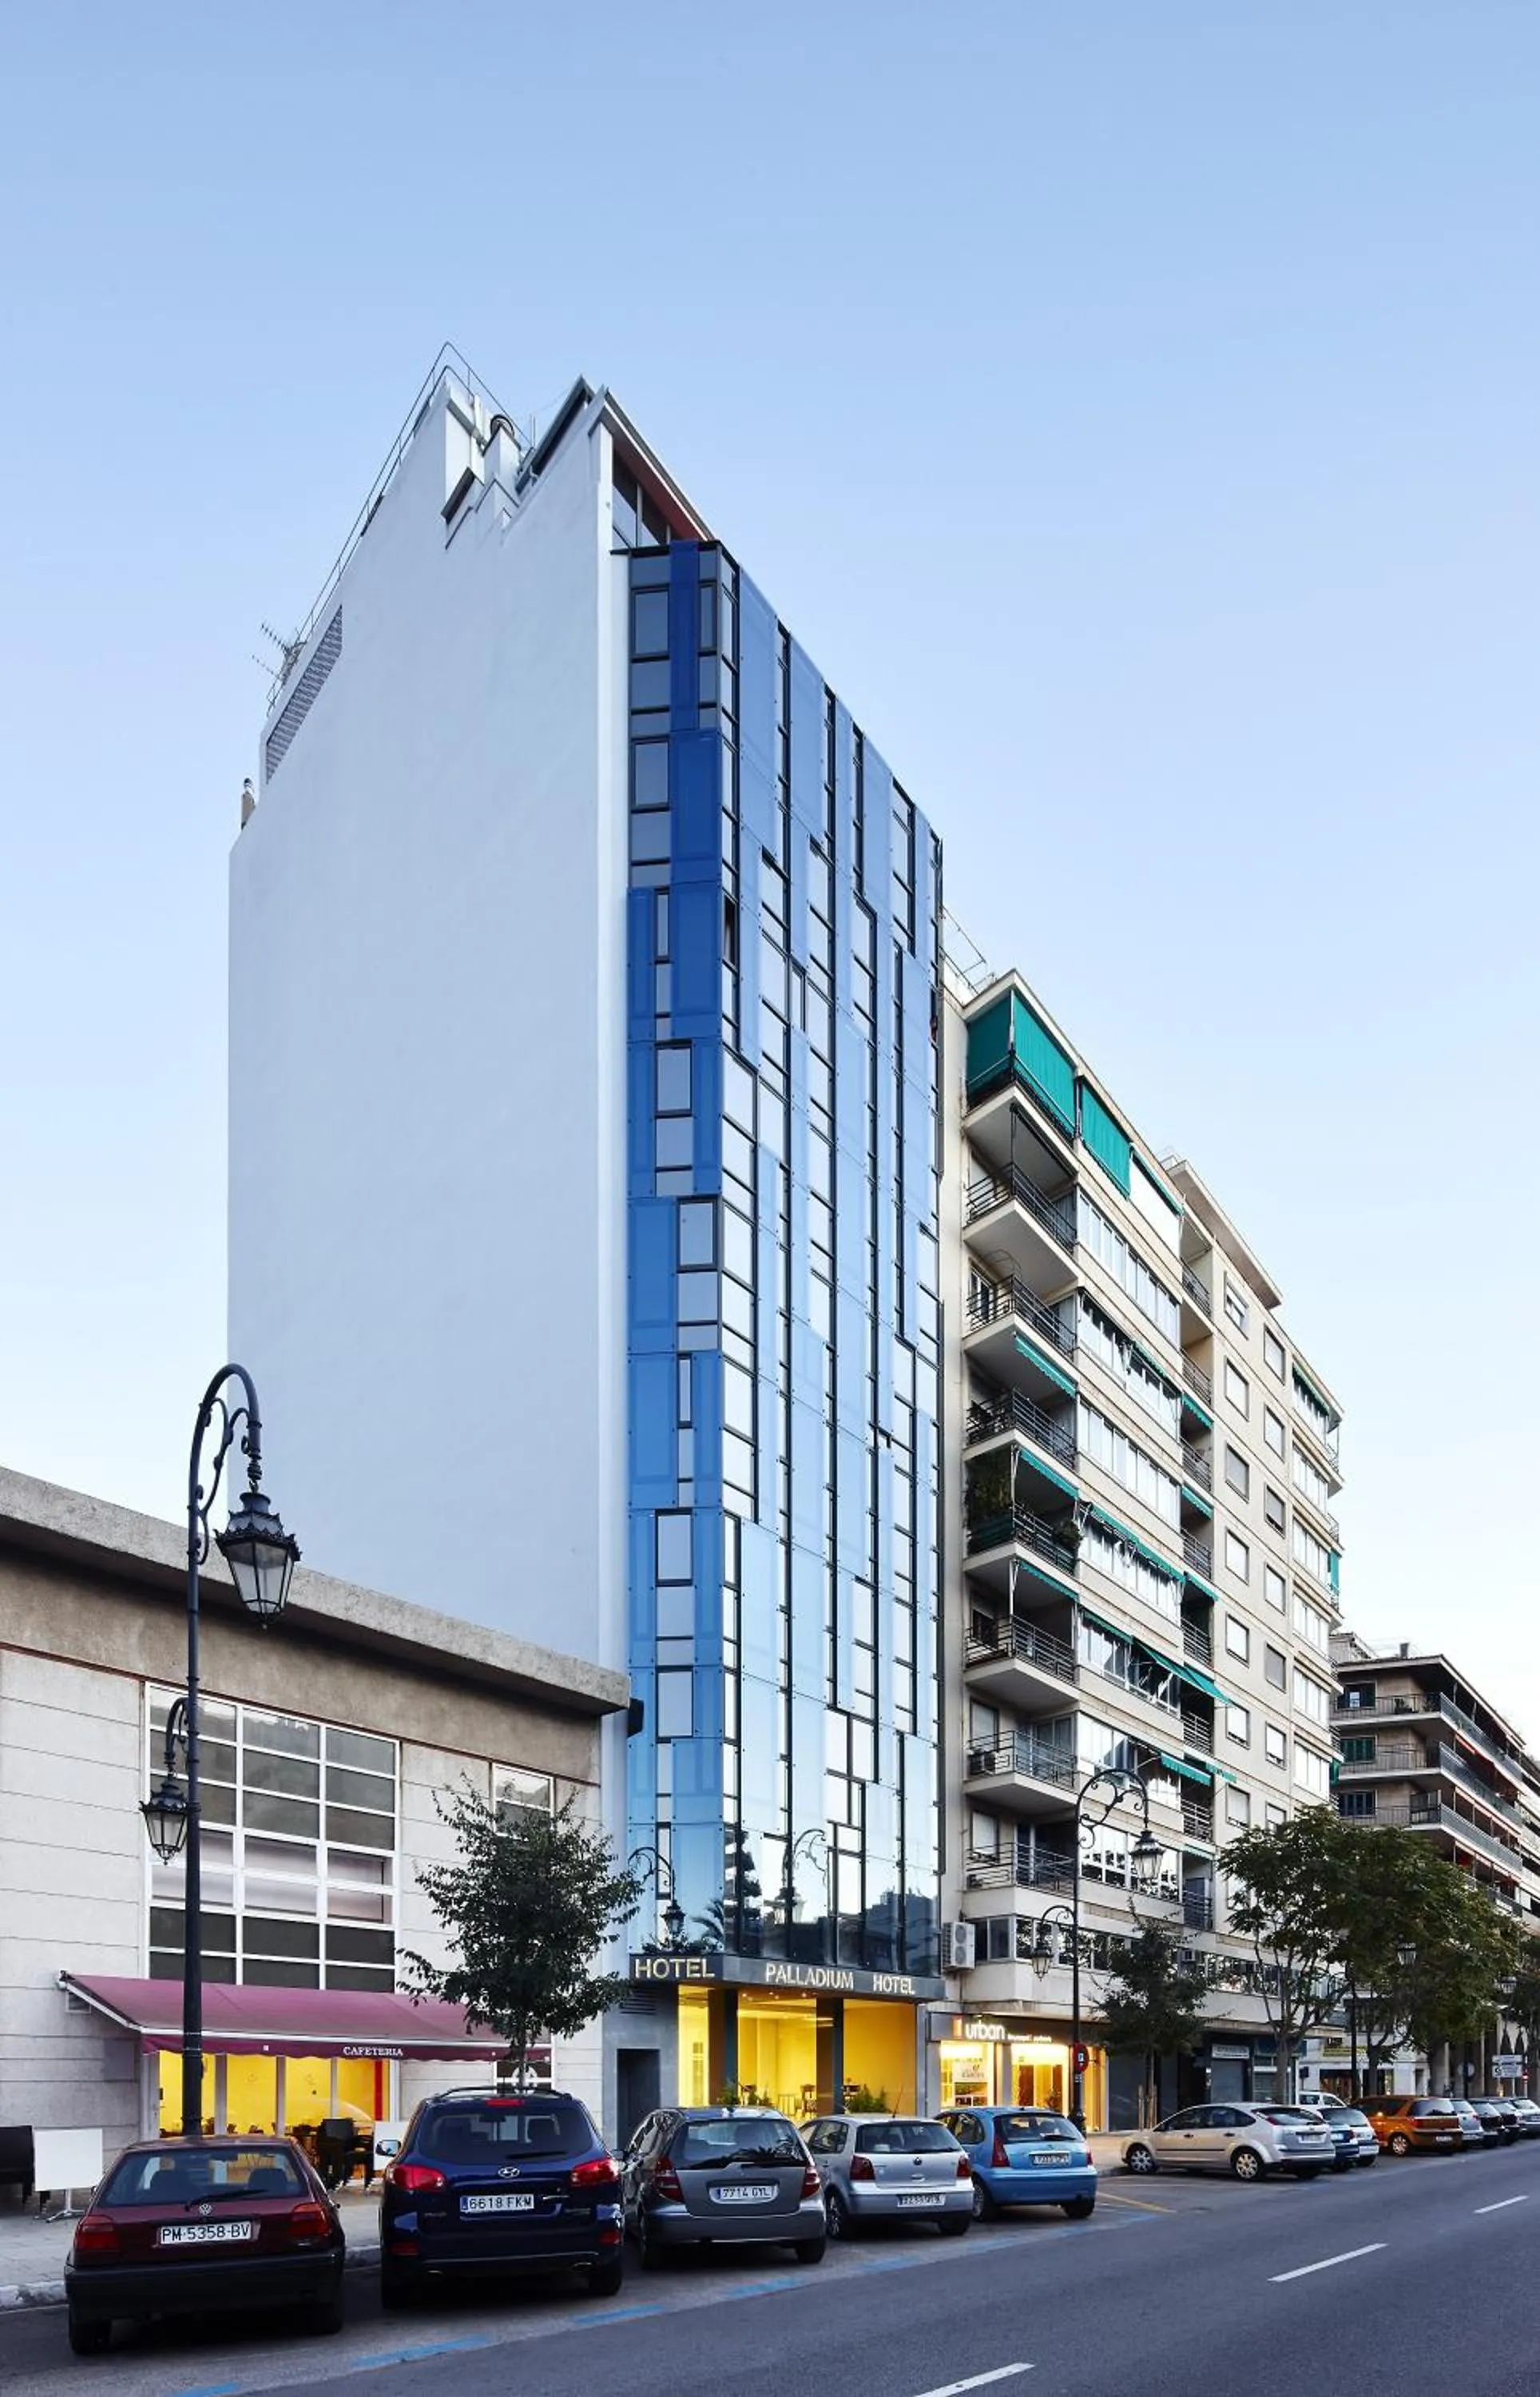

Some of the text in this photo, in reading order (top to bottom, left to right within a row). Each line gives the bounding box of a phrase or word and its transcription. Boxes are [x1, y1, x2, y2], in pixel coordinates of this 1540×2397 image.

[634, 1958, 716, 1978] HOTEL
[765, 1962, 916, 1995] PALLADIUM HOTEL
[965, 2020, 1006, 2040] urban
[343, 2046, 403, 2057] CAFETERIA
[469, 2196, 532, 2210] 6618 FKM
